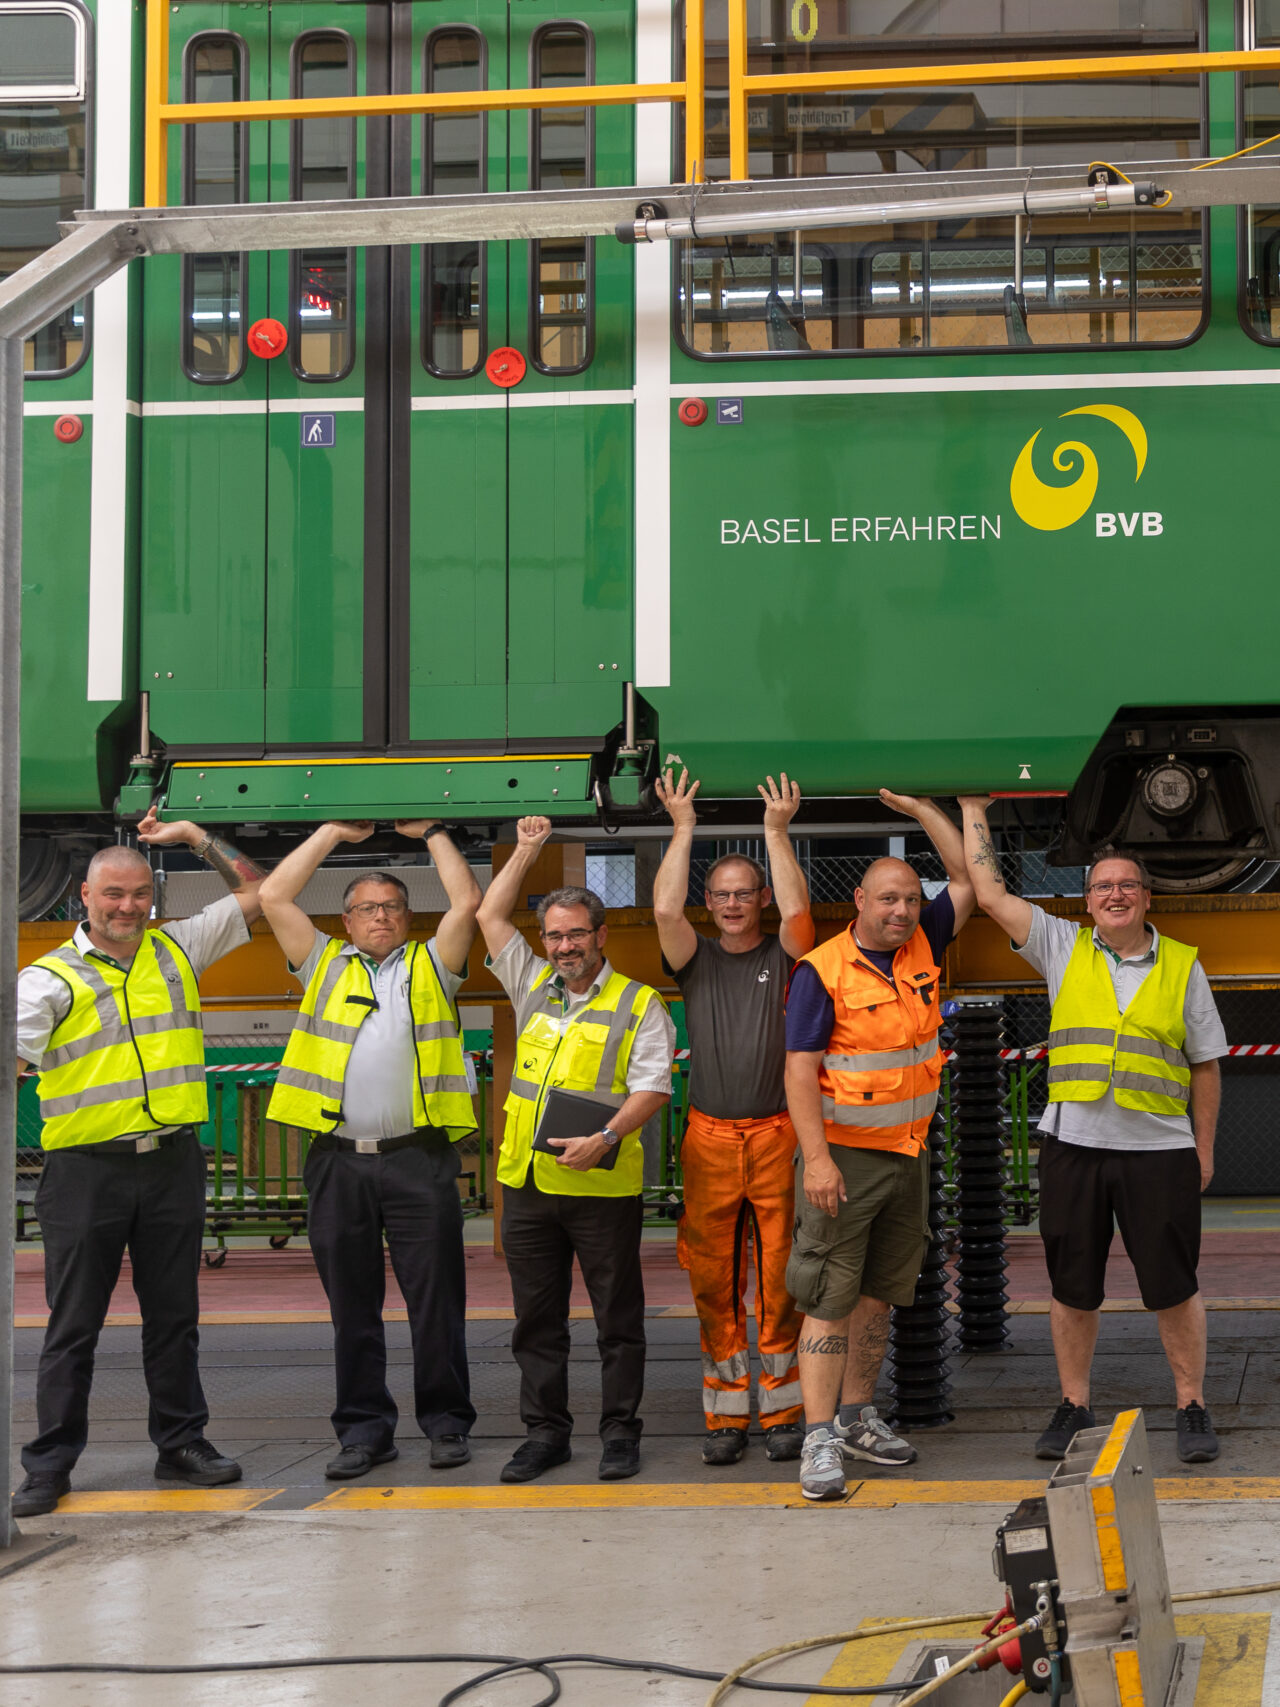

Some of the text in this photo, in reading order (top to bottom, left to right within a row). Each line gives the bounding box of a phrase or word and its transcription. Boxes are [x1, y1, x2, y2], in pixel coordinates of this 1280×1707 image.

[720, 515, 1001, 545] BASEL ERFAHREN
[1095, 512, 1164, 537] BVB
